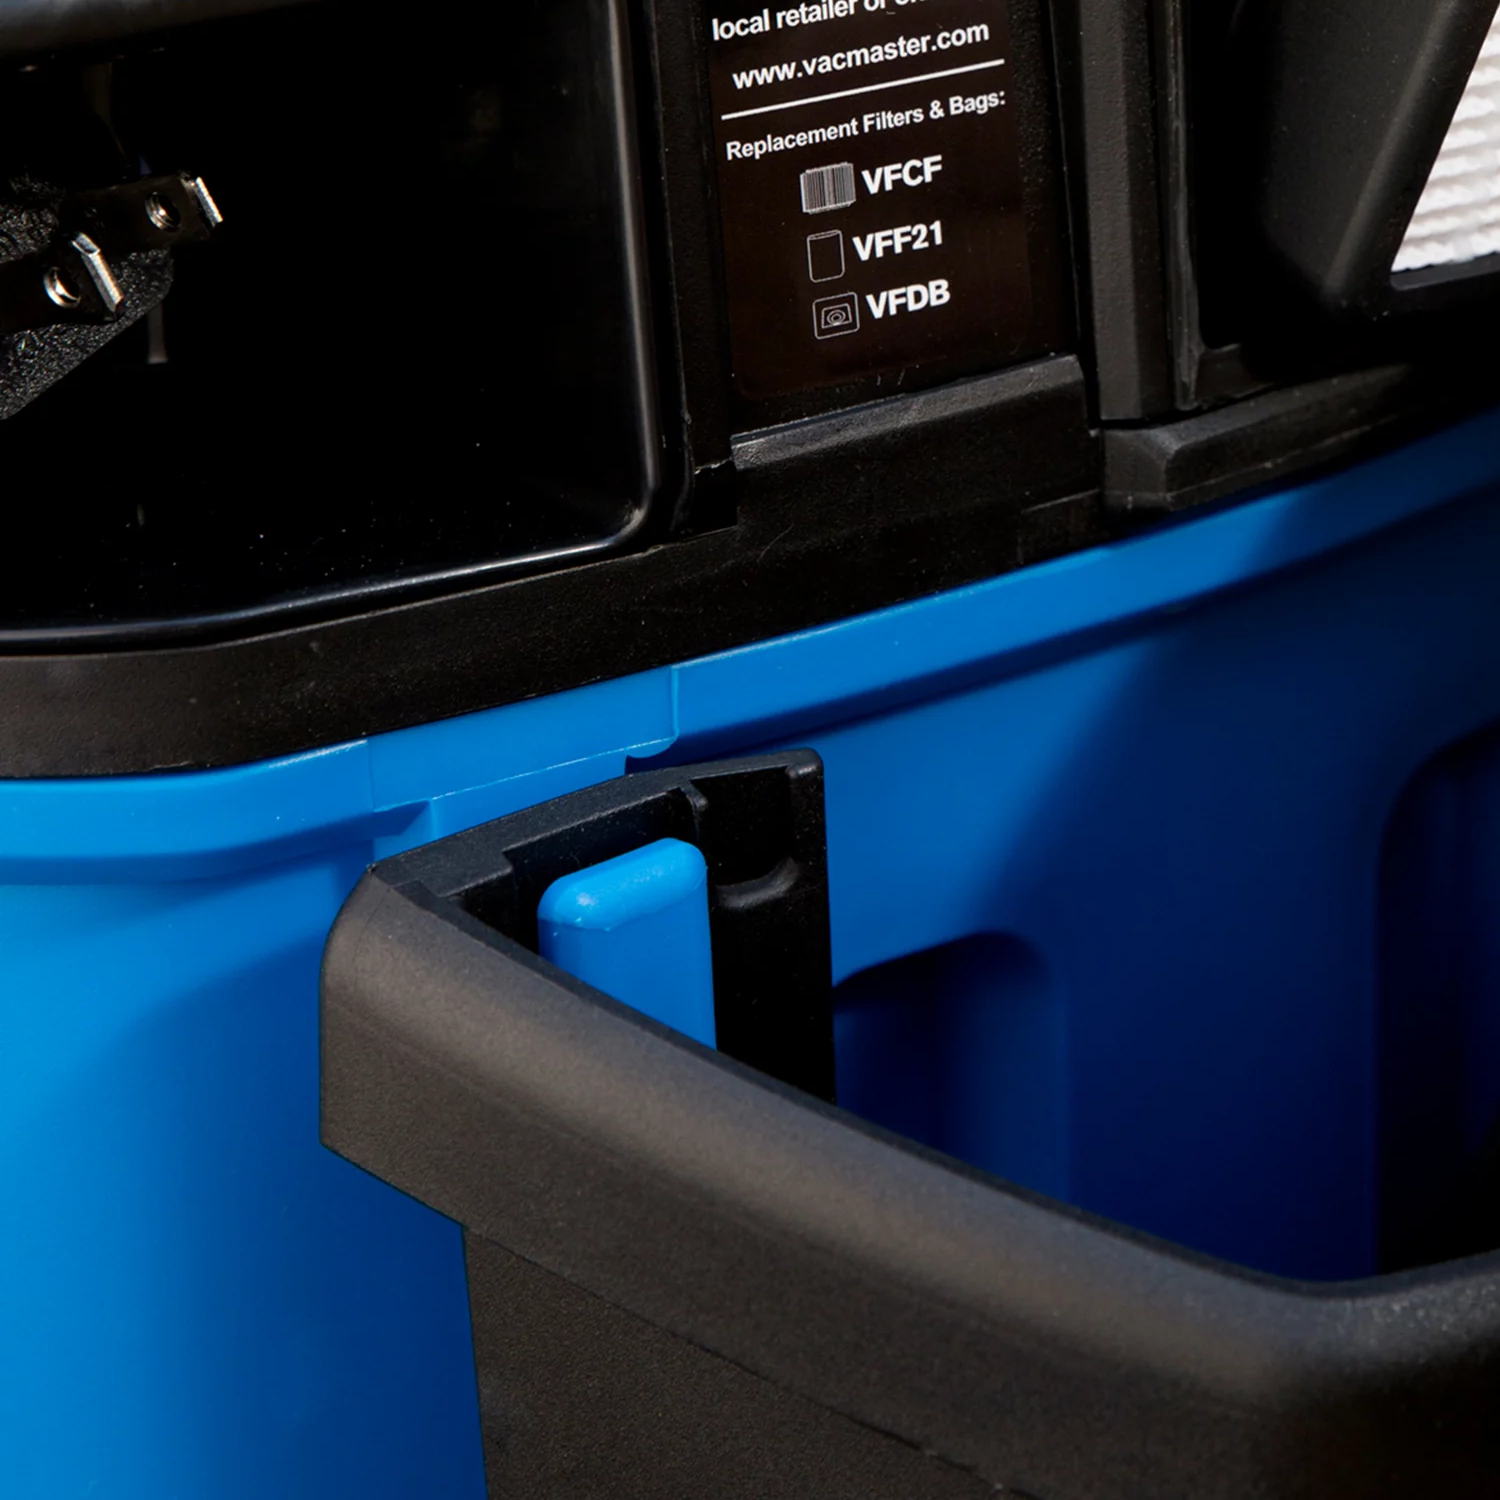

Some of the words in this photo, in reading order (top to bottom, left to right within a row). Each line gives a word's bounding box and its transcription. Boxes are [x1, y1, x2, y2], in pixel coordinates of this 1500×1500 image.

[712, 9, 771, 41] local
[732, 22, 990, 90] www.vacmaster.com
[725, 116, 859, 161] Replacement
[862, 108, 924, 134] Filters
[929, 100, 945, 120] &
[949, 90, 1006, 118] Bags:
[861, 154, 943, 195] VFCF
[852, 220, 943, 262] VFF21
[865, 278, 951, 320] VFDB
